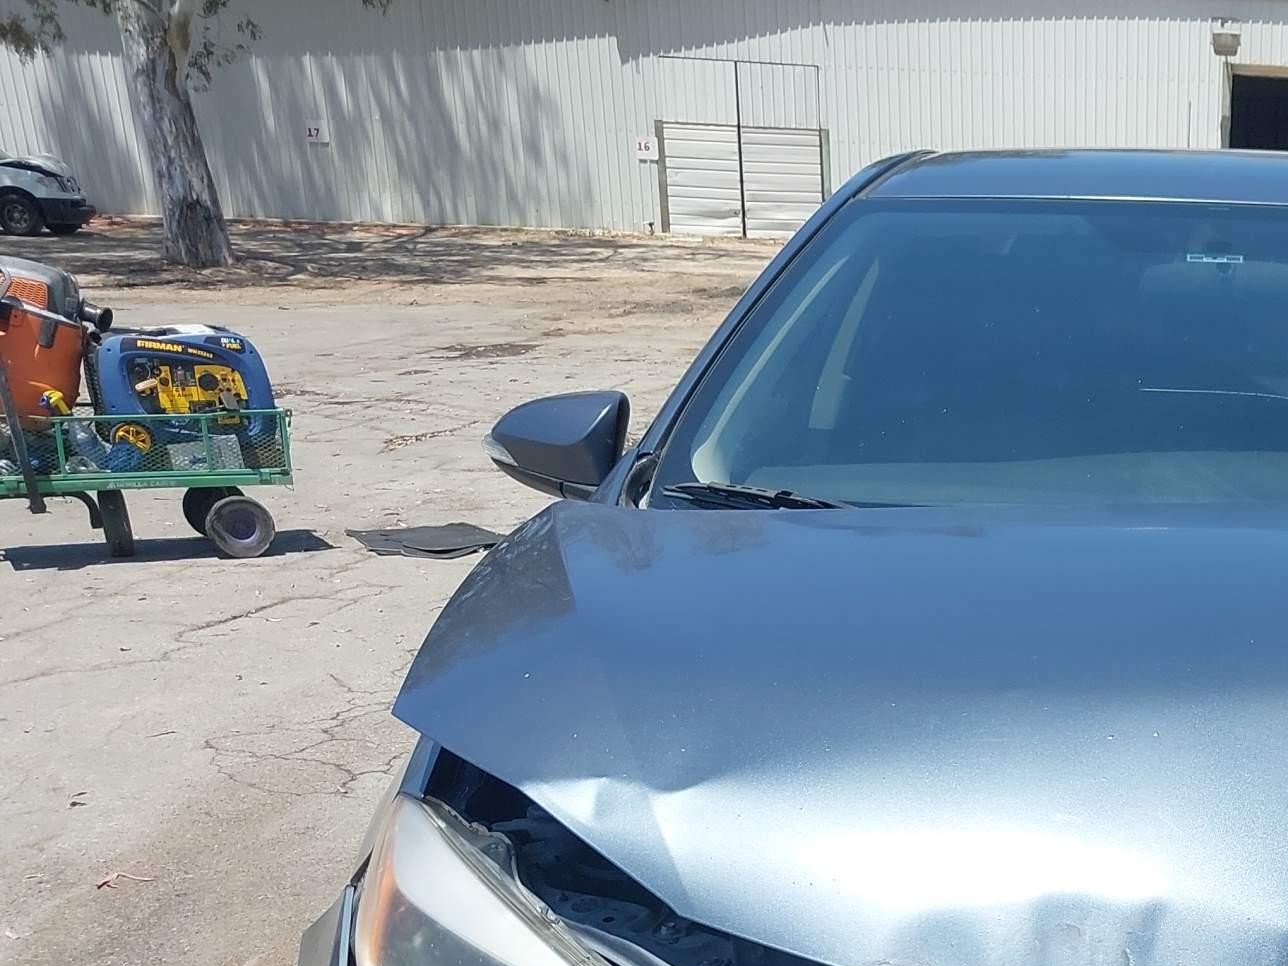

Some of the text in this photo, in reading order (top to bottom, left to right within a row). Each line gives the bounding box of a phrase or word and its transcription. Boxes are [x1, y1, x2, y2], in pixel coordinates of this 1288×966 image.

[307, 127, 320, 138] 17
[634, 141, 651, 152] 16
[136, 339, 183, 353] FIRMAN
